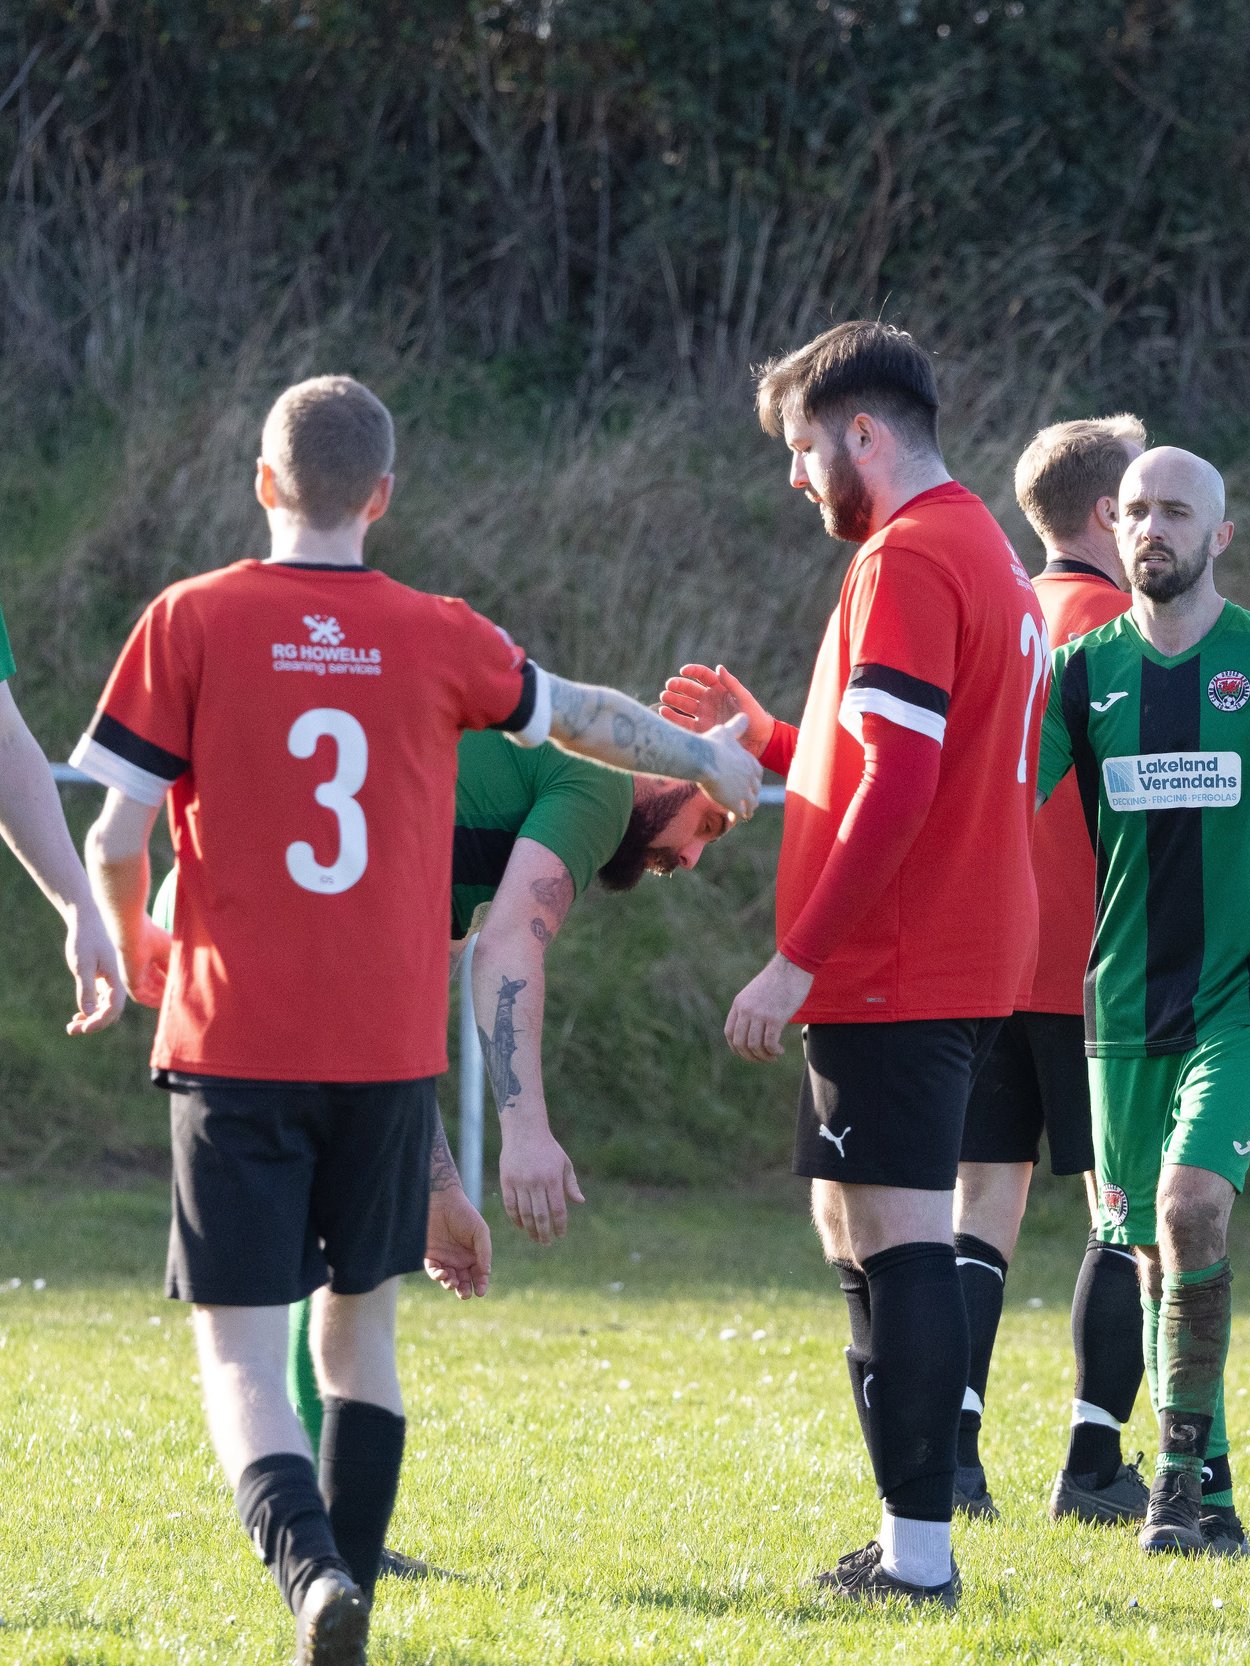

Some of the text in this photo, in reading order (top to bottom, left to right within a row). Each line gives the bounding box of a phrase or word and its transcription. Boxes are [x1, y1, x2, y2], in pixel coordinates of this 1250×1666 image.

[272, 643, 382, 664] RG HOWELLS
[273, 660, 382, 676] cleaning services
[1137, 757, 1218, 775] Lakeland
[1139, 774, 1237, 791] Verandahs
[286, 708, 368, 894] 3
[1112, 793, 1237, 806] DECKING FENCING PERGOLAS
